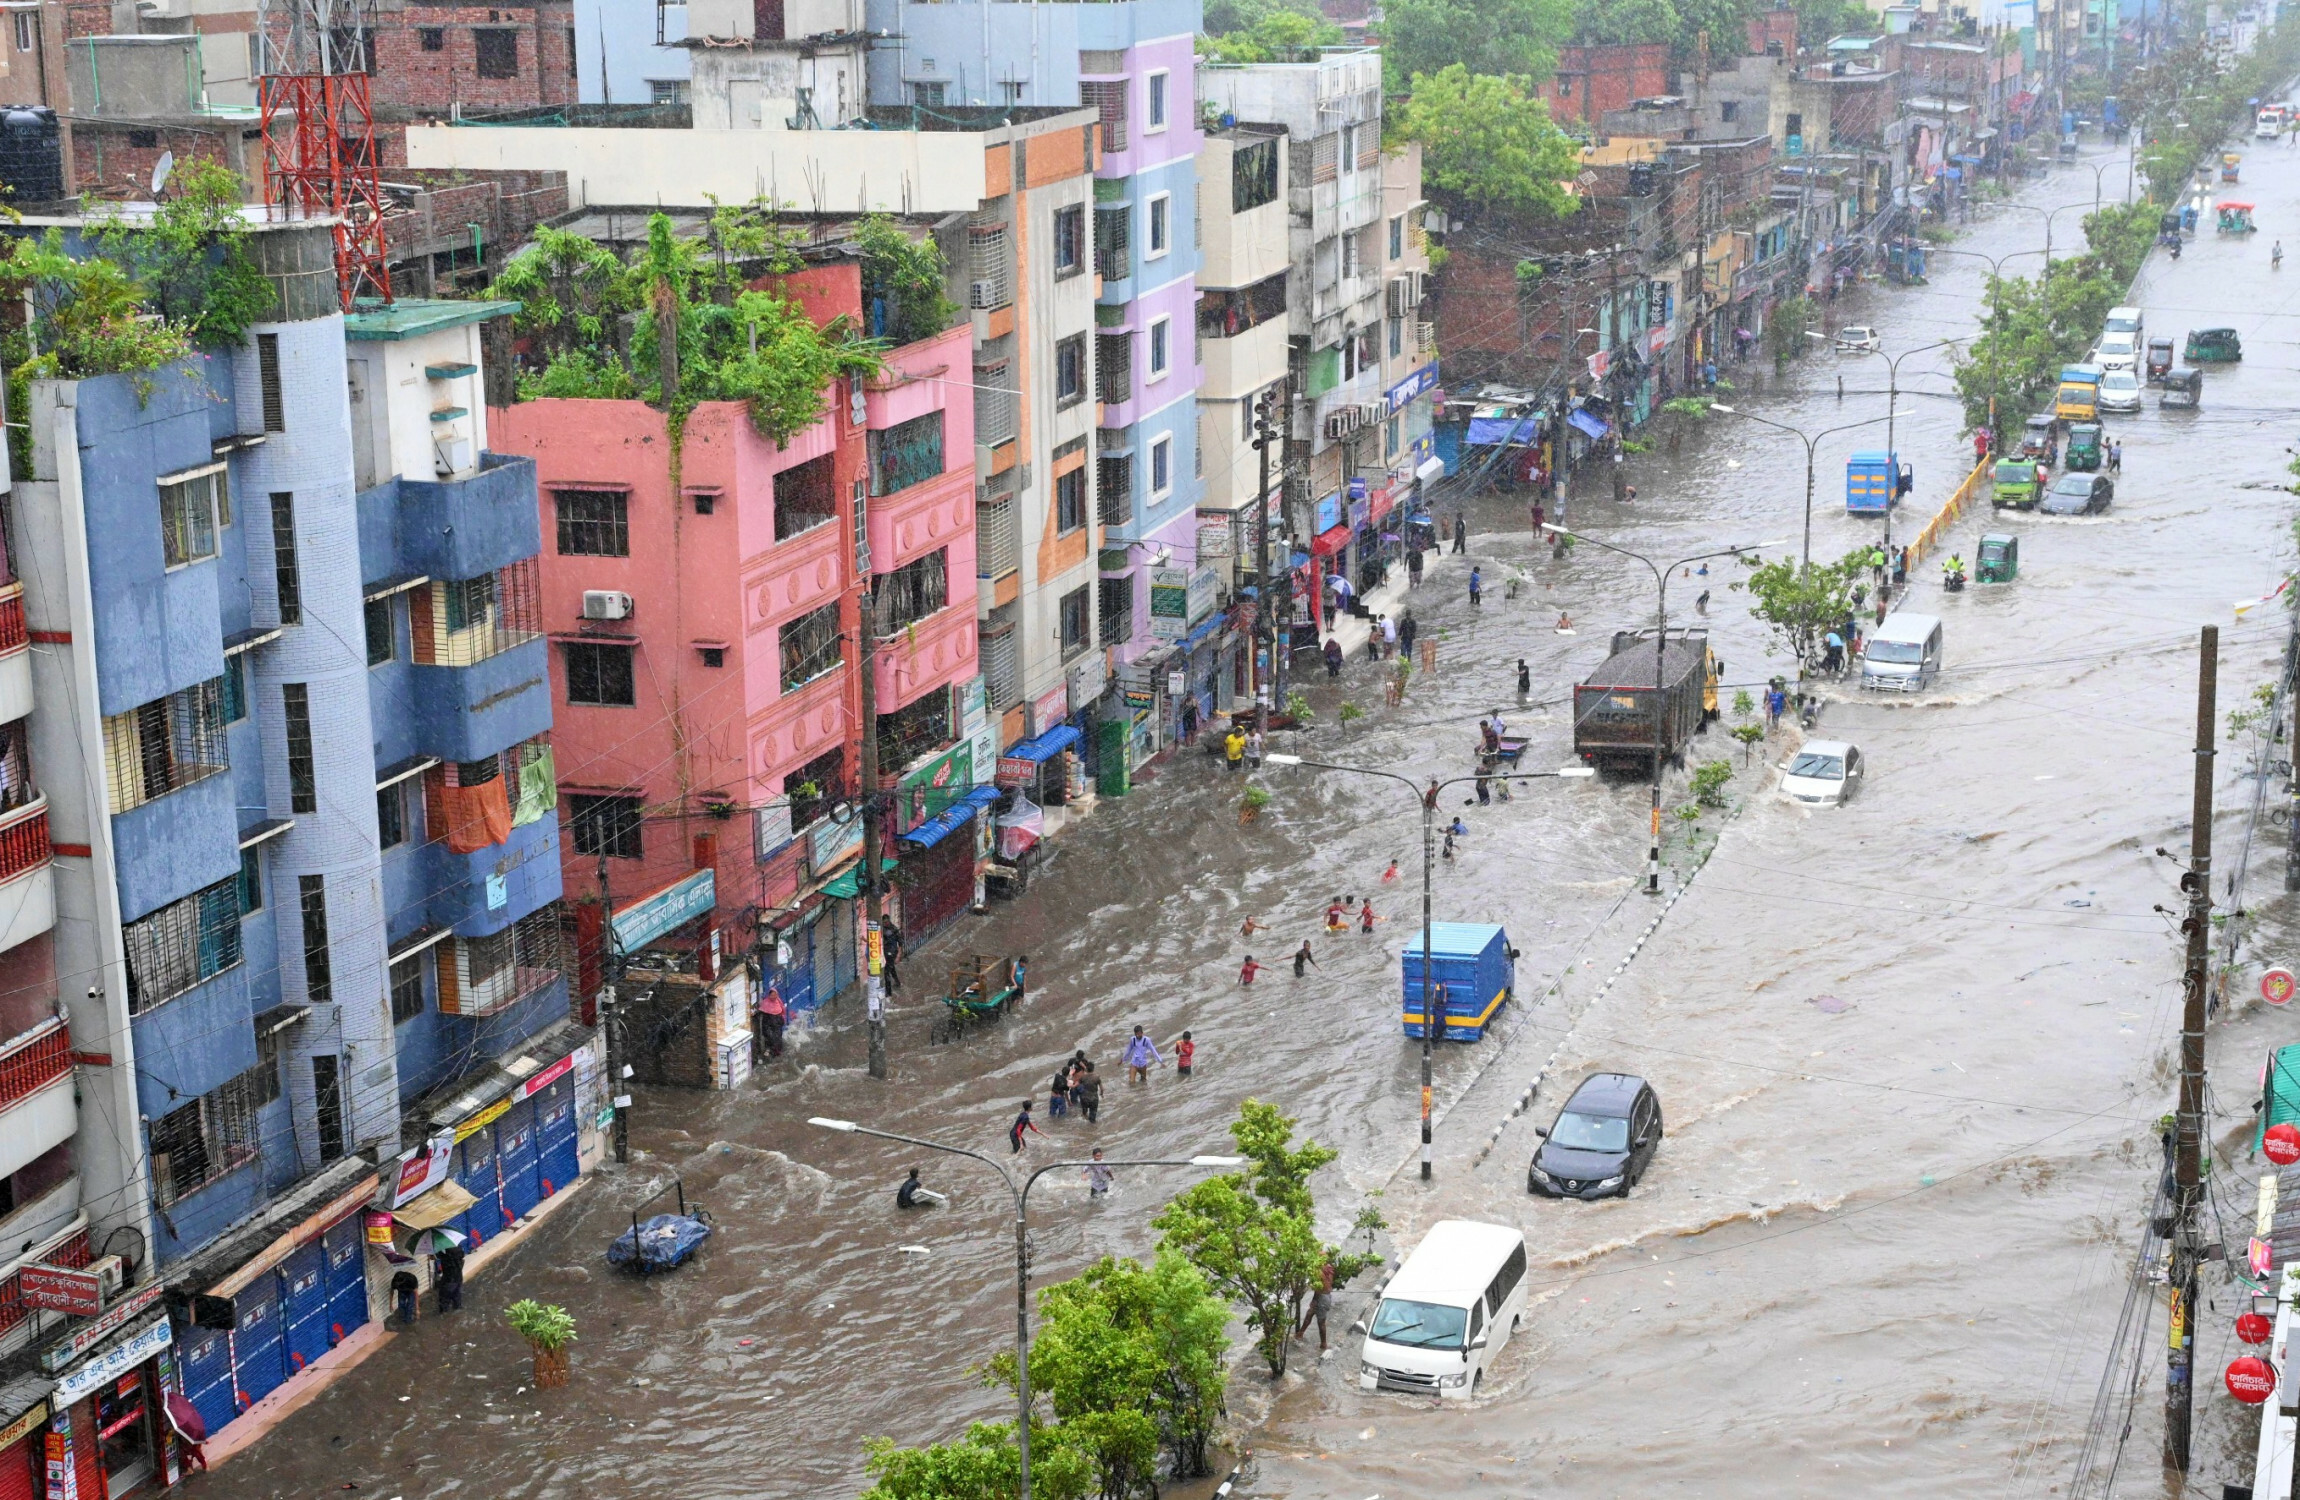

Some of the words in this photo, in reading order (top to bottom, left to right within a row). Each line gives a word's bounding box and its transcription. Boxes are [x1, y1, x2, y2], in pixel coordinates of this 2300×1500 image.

[869, 932, 878, 959] UCC
[22, 1273, 48, 1286] এখানে
[100, 1305, 126, 1331] EYE
[129, 1285, 163, 1312] CARE
[66, 1372, 87, 1390] আর
[90, 1360, 104, 1377] এন
[106, 1346, 128, 1366] আই
[129, 1331, 156, 1356] কেয়ার
[2229, 1373, 2265, 1384] ফার্নিচার
[2233, 1382, 2271, 1393] কনসেপ্ট
